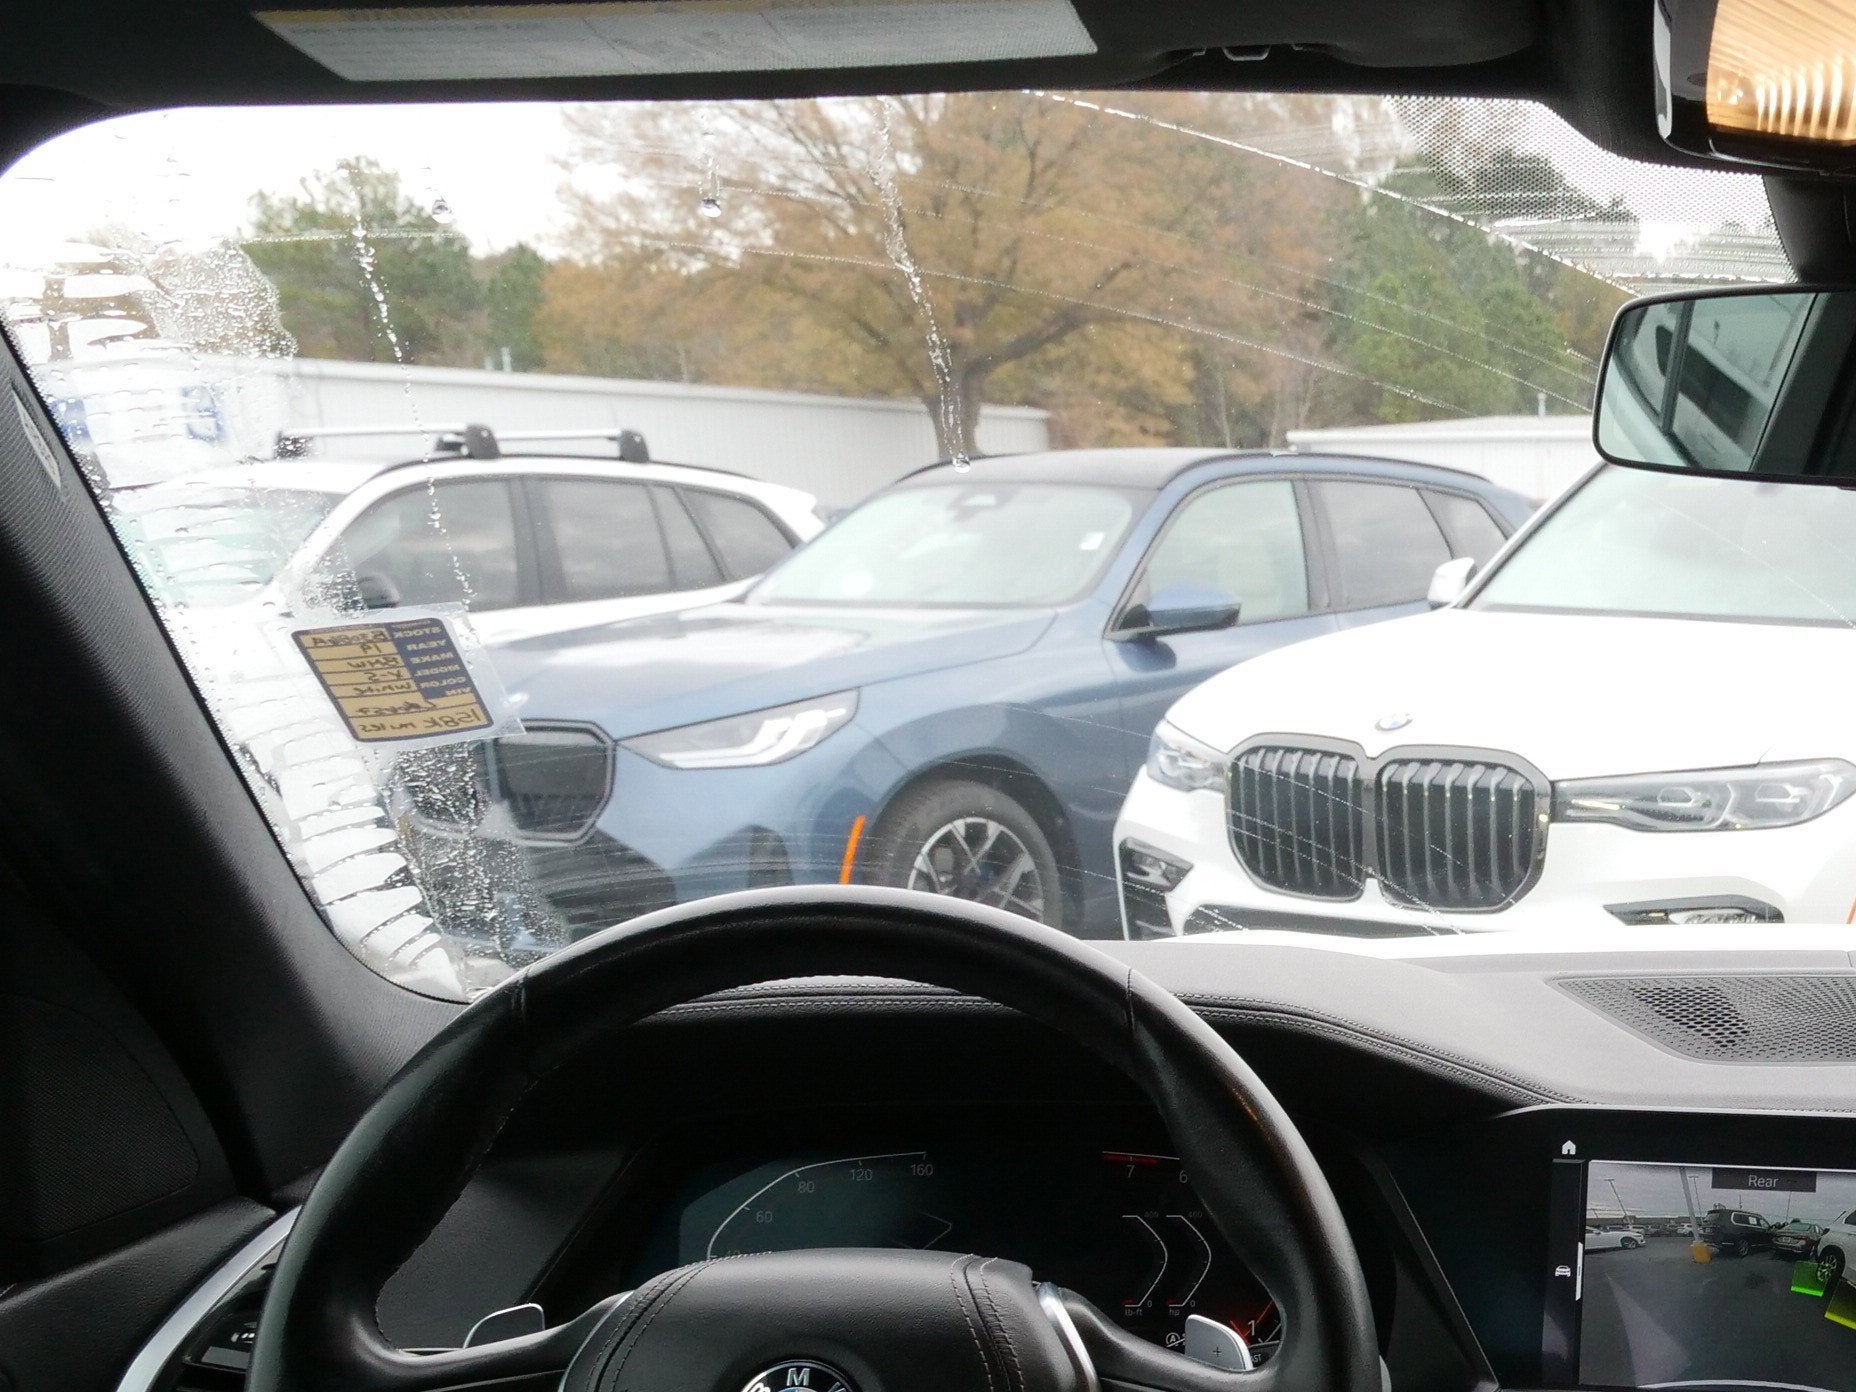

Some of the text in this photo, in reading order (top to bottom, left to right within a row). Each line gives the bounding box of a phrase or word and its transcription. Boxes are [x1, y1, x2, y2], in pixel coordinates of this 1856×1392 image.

[851, 1169, 873, 1181] 120
[911, 1164, 934, 1176] 160
[1127, 1165, 1135, 1178] 7
[1179, 1170, 1188, 1184] 6
[1748, 1174, 1779, 1188] Rear
[797, 1181, 815, 1193] 80
[756, 1210, 773, 1223] 60
[1248, 1320, 1255, 1336] 1
